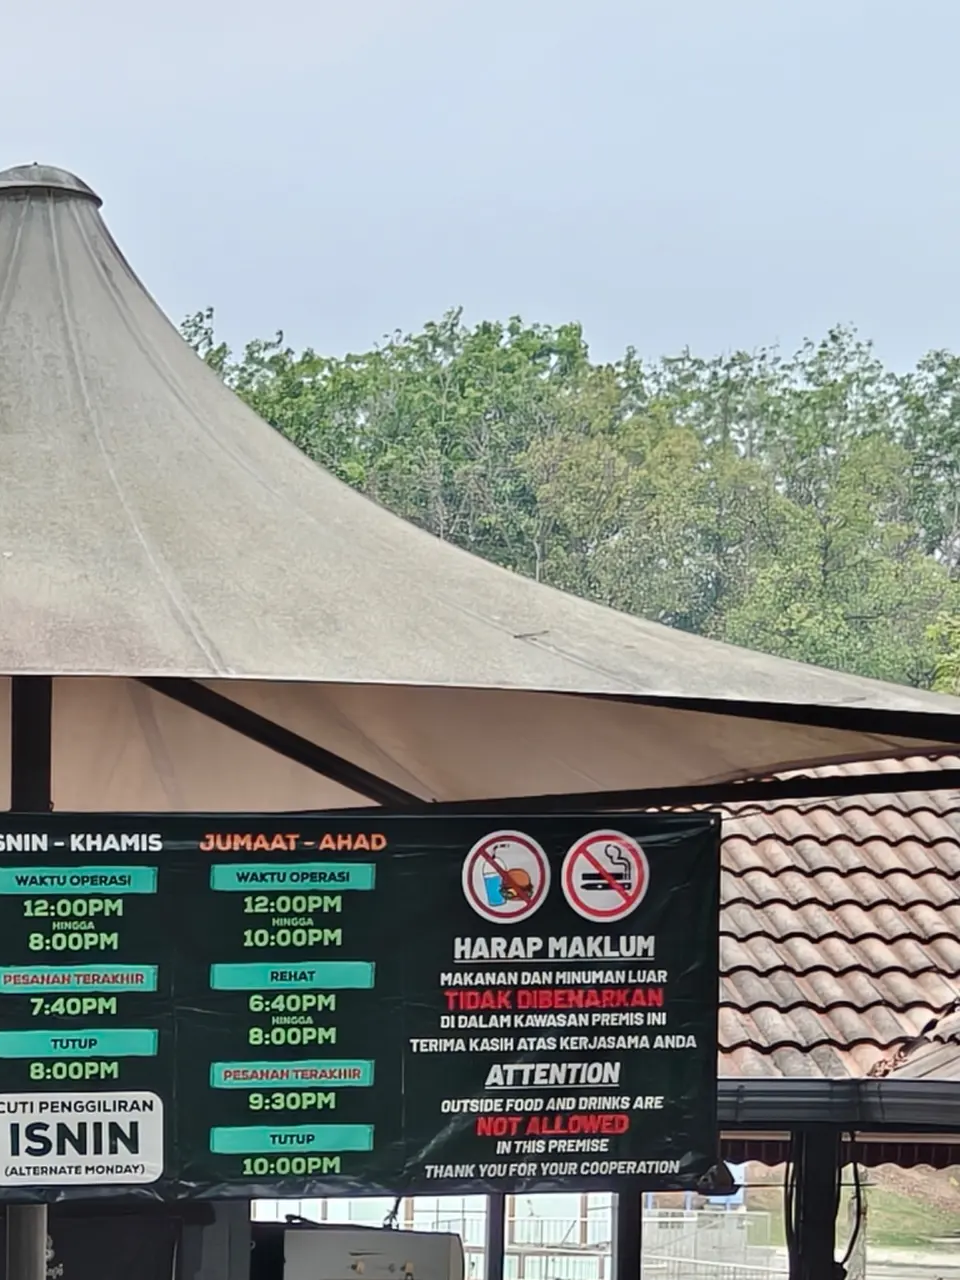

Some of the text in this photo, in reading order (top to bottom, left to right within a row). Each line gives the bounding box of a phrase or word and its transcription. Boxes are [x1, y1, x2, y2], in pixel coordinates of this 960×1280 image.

[70, 834, 163, 851] KHAMIS
[199, 834, 300, 851] JUMAAT
[319, 833, 387, 851] AHAD
[15, 875, 131, 886] WAKTU OPERASI
[236, 871, 350, 883] WAKTU OPERASI
[23, 899, 123, 917] 12:00PM
[243, 895, 342, 913] 12:00PM
[52, 921, 95, 930] HINGGA
[271, 917, 314, 926] HINGGA
[28, 932, 118, 951] 8:00PM
[243, 929, 342, 947] 10:00PM
[454, 935, 655, 959] HARAP MAKLUM
[3, 973, 144, 985] PESANAN TERAKHIR
[270, 971, 316, 982] REHAT
[440, 969, 667, 986] MAKANAN DAN MINUMAN LUAR
[30, 997, 117, 1015] 7:40PM
[249, 994, 336, 1012] 6:40PM
[444, 988, 664, 1011] TIDAK DIBENARKAN
[271, 1016, 313, 1025] HINGGA
[440, 1012, 667, 1029] DI DALAM KAWASAN PREMIS INI
[50, 1038, 98, 1049] TUTUP
[248, 1027, 336, 1045] 8:00PM
[409, 1035, 697, 1053] TERIMA KASIH ATAS KERJASAMA ANDA
[29, 1061, 119, 1080] 8:00PM
[223, 1068, 361, 1081] PESANAN TERAKHIR
[484, 1062, 621, 1086] ATTENTION
[39, 1100, 154, 1113] PENGGILIRAN
[248, 1092, 336, 1110] 9:30PM
[441, 1096, 664, 1112] OUTSIDE FOOD AND DRINKS ARE
[475, 1113, 630, 1137] NOT ALLOWED
[9, 1121, 140, 1157] ISNIN
[269, 1133, 315, 1145] TUTUP
[496, 1139, 609, 1154] IN THIS PREMISE
[4, 1164, 145, 1177] (ALTERNATE MONDAY)
[243, 1156, 341, 1175] 10:00PM
[425, 1160, 680, 1179] THANK YOU FOR YOUR COOPERATION
